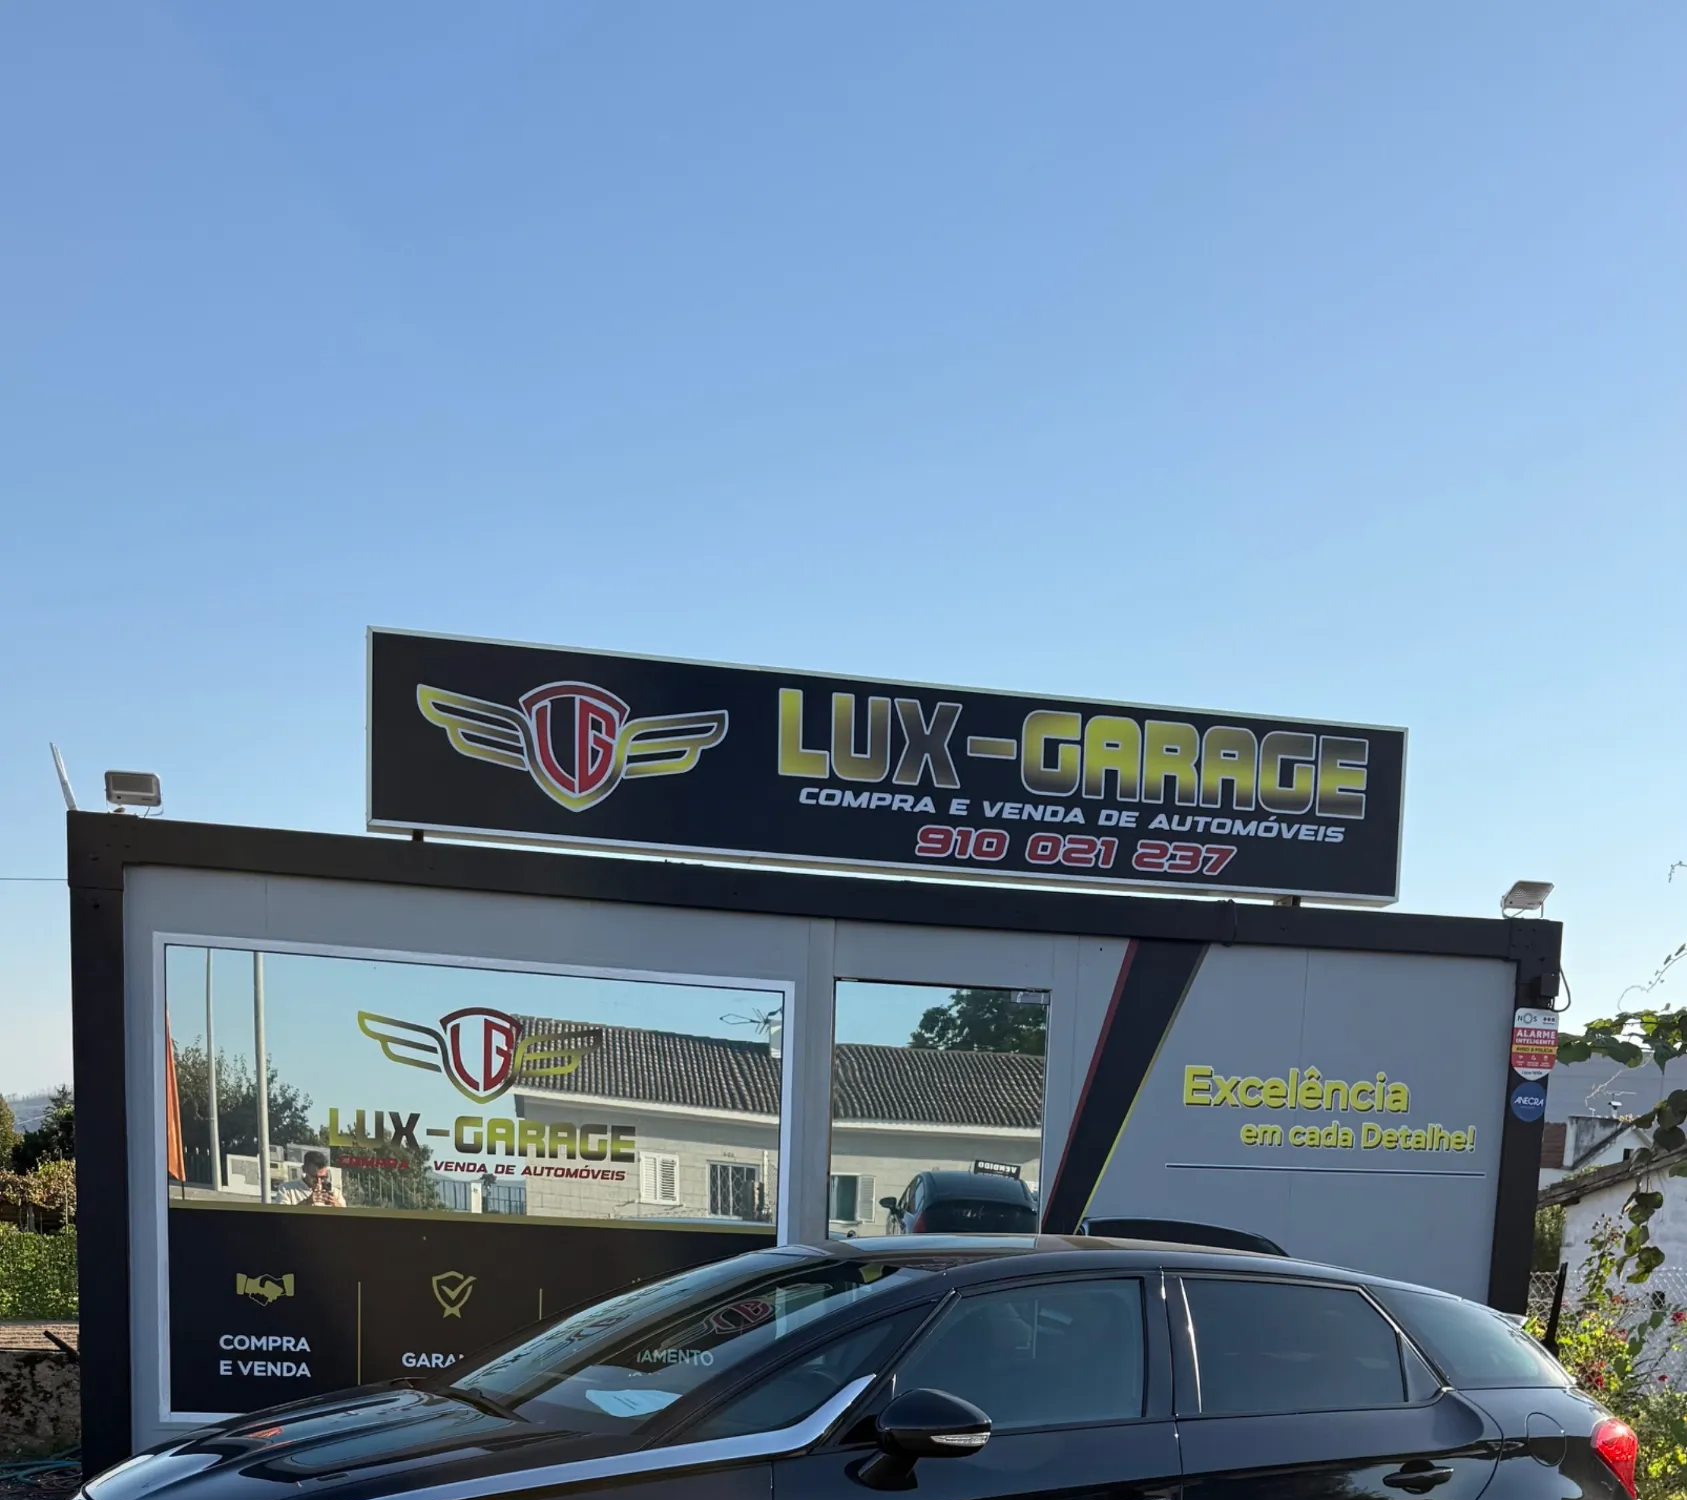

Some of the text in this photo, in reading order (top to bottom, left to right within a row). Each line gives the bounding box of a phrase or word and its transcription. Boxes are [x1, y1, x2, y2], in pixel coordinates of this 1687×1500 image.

[778, 688, 1369, 820] LUX-GARAGE
[799, 787, 1346, 843] COMPRA E VENDA DE AUTOMÓVEIS
[915, 825, 1237, 876] 910 021 237
[1517, 1013, 1538, 1024] NOS
[1515, 1038, 1556, 1046] INTELIGENTE
[1516, 1029, 1556, 1039] ALARME
[1183, 1065, 1410, 1113] Excelência
[1514, 1096, 1544, 1106] ANECRA
[329, 1107, 636, 1163] LUX-GARAGE
[1240, 1122, 1476, 1153] em cada Detalhe!
[338, 1155, 626, 1181] COMPRA VENDA DE AUTOMÓVEIS
[219, 1334, 311, 1352] COMPRA
[220, 1360, 311, 1377] E VENDA
[401, 1352, 464, 1368] GARA
